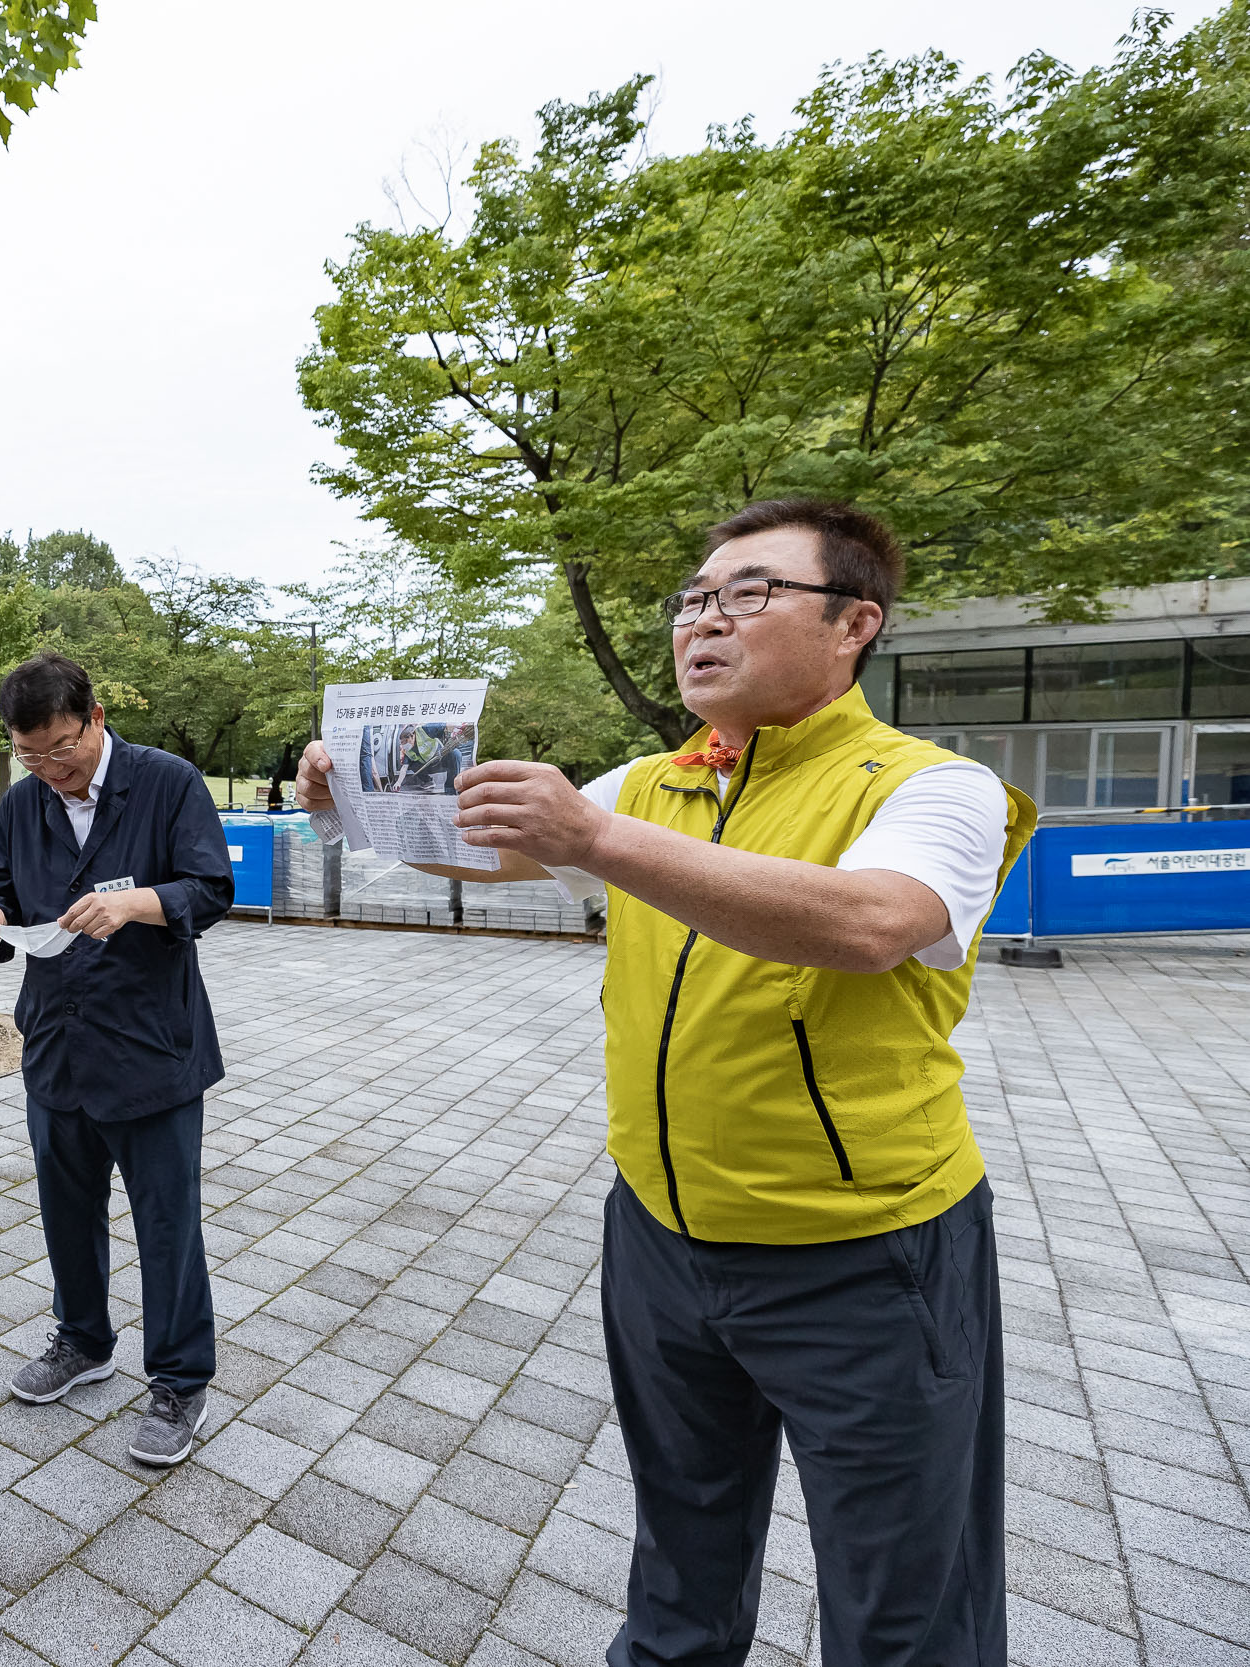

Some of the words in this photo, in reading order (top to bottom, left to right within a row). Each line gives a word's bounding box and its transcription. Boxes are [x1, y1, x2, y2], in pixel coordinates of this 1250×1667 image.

[336, 708, 356, 719] 15개동
[356, 706, 370, 719] 골목
[385, 704, 401, 717] 민원
[401, 703, 416, 716] 줍는
[1147, 853, 1247, 870] 서울어린이대공원
